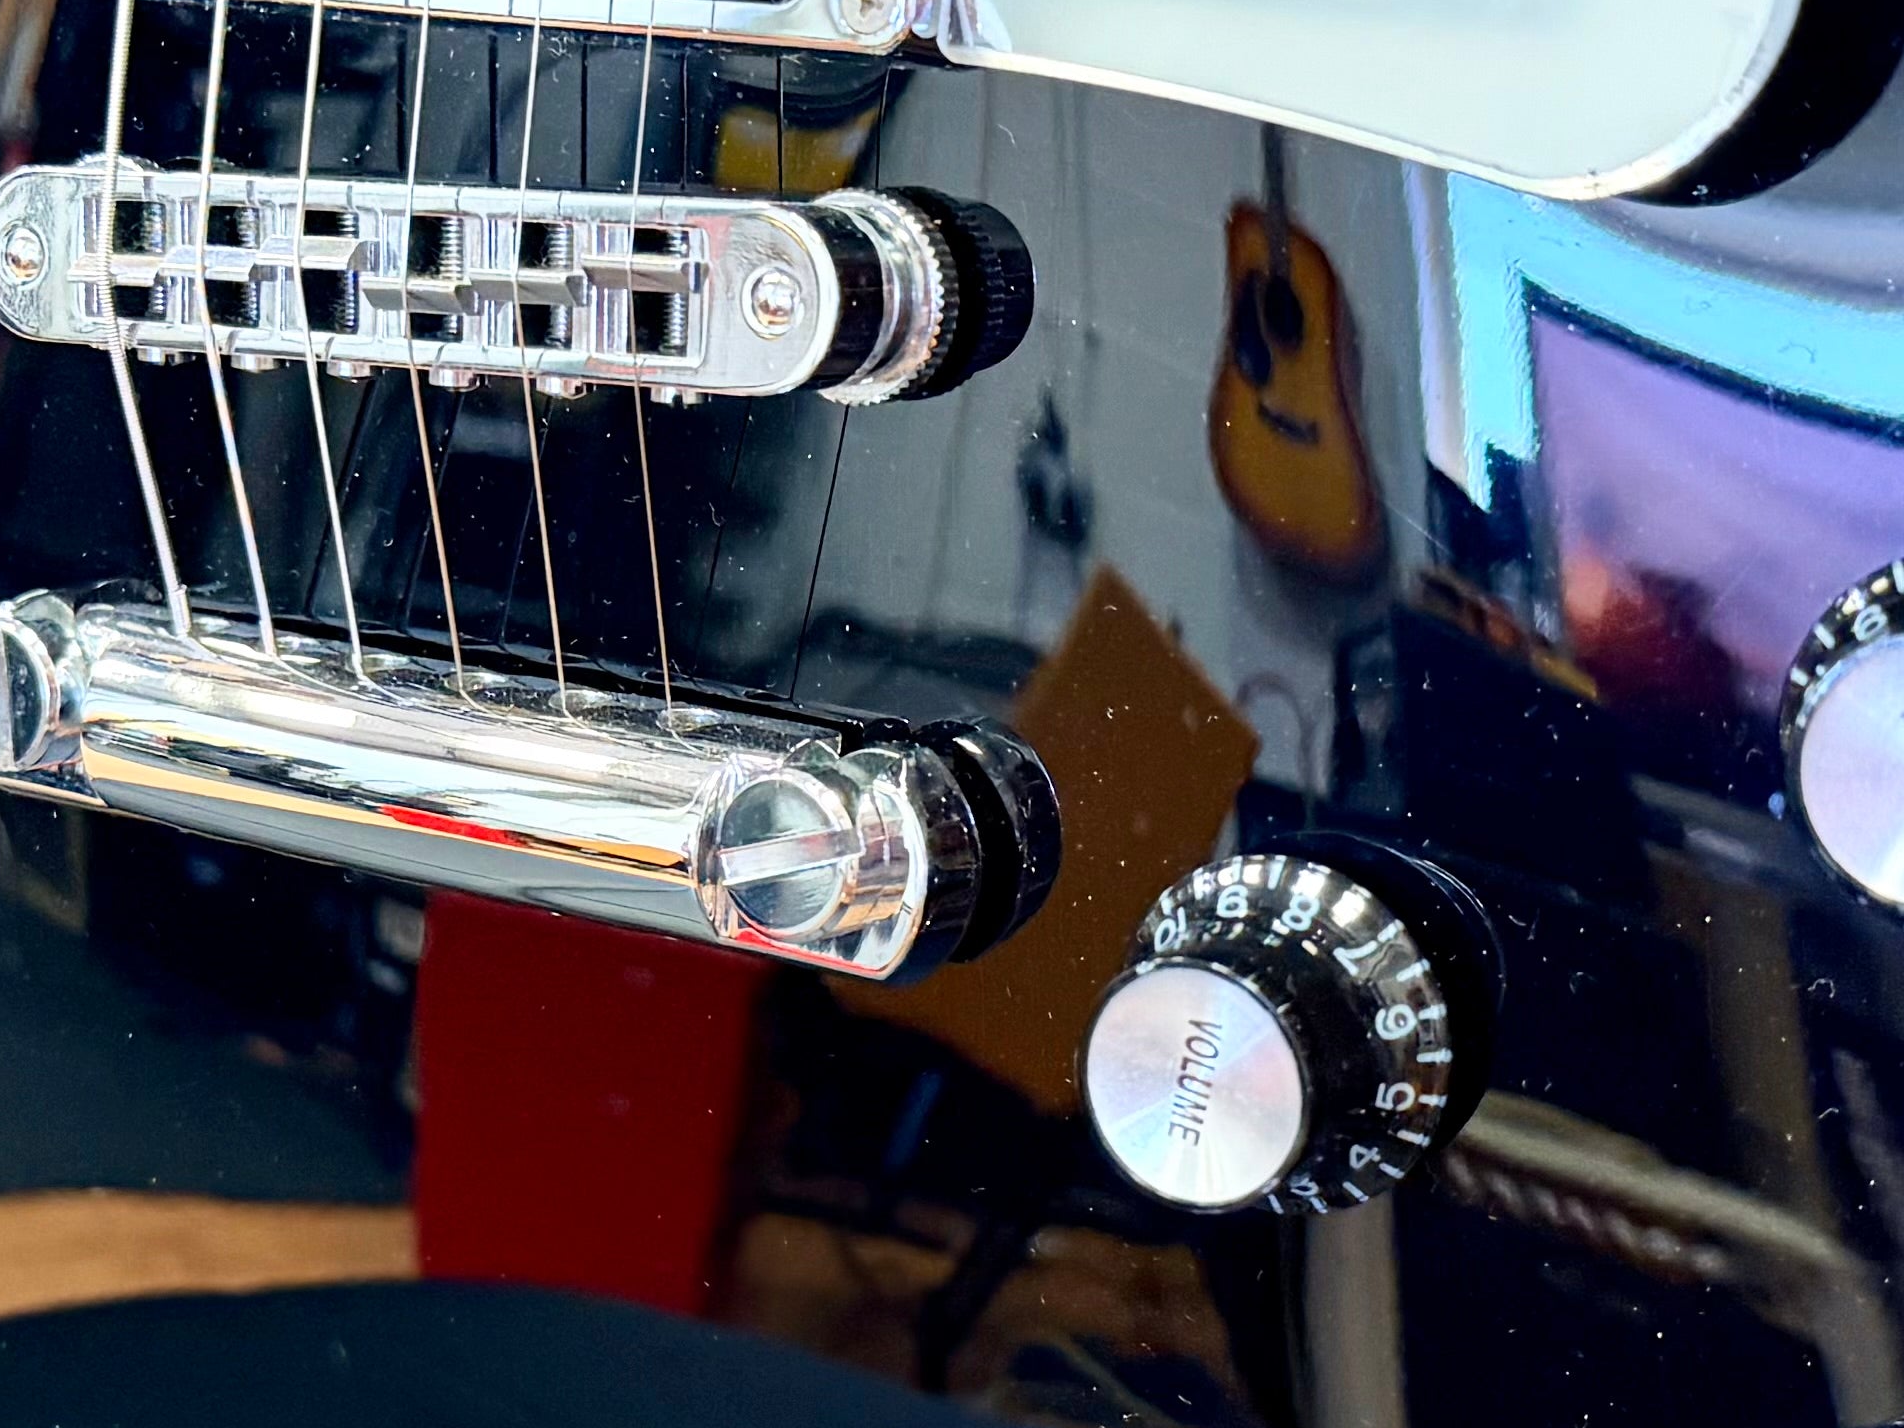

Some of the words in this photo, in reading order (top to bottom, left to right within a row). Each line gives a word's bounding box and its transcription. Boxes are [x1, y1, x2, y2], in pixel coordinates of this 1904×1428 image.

[1281, 892, 1321, 932] 8
[1332, 940, 1379, 977] 7
[1374, 1003, 1418, 1040] 6
[1167, 1018, 1223, 1147] VOLUME
[1376, 1082, 1416, 1112] 5
[1349, 1144, 1381, 1169] 4
